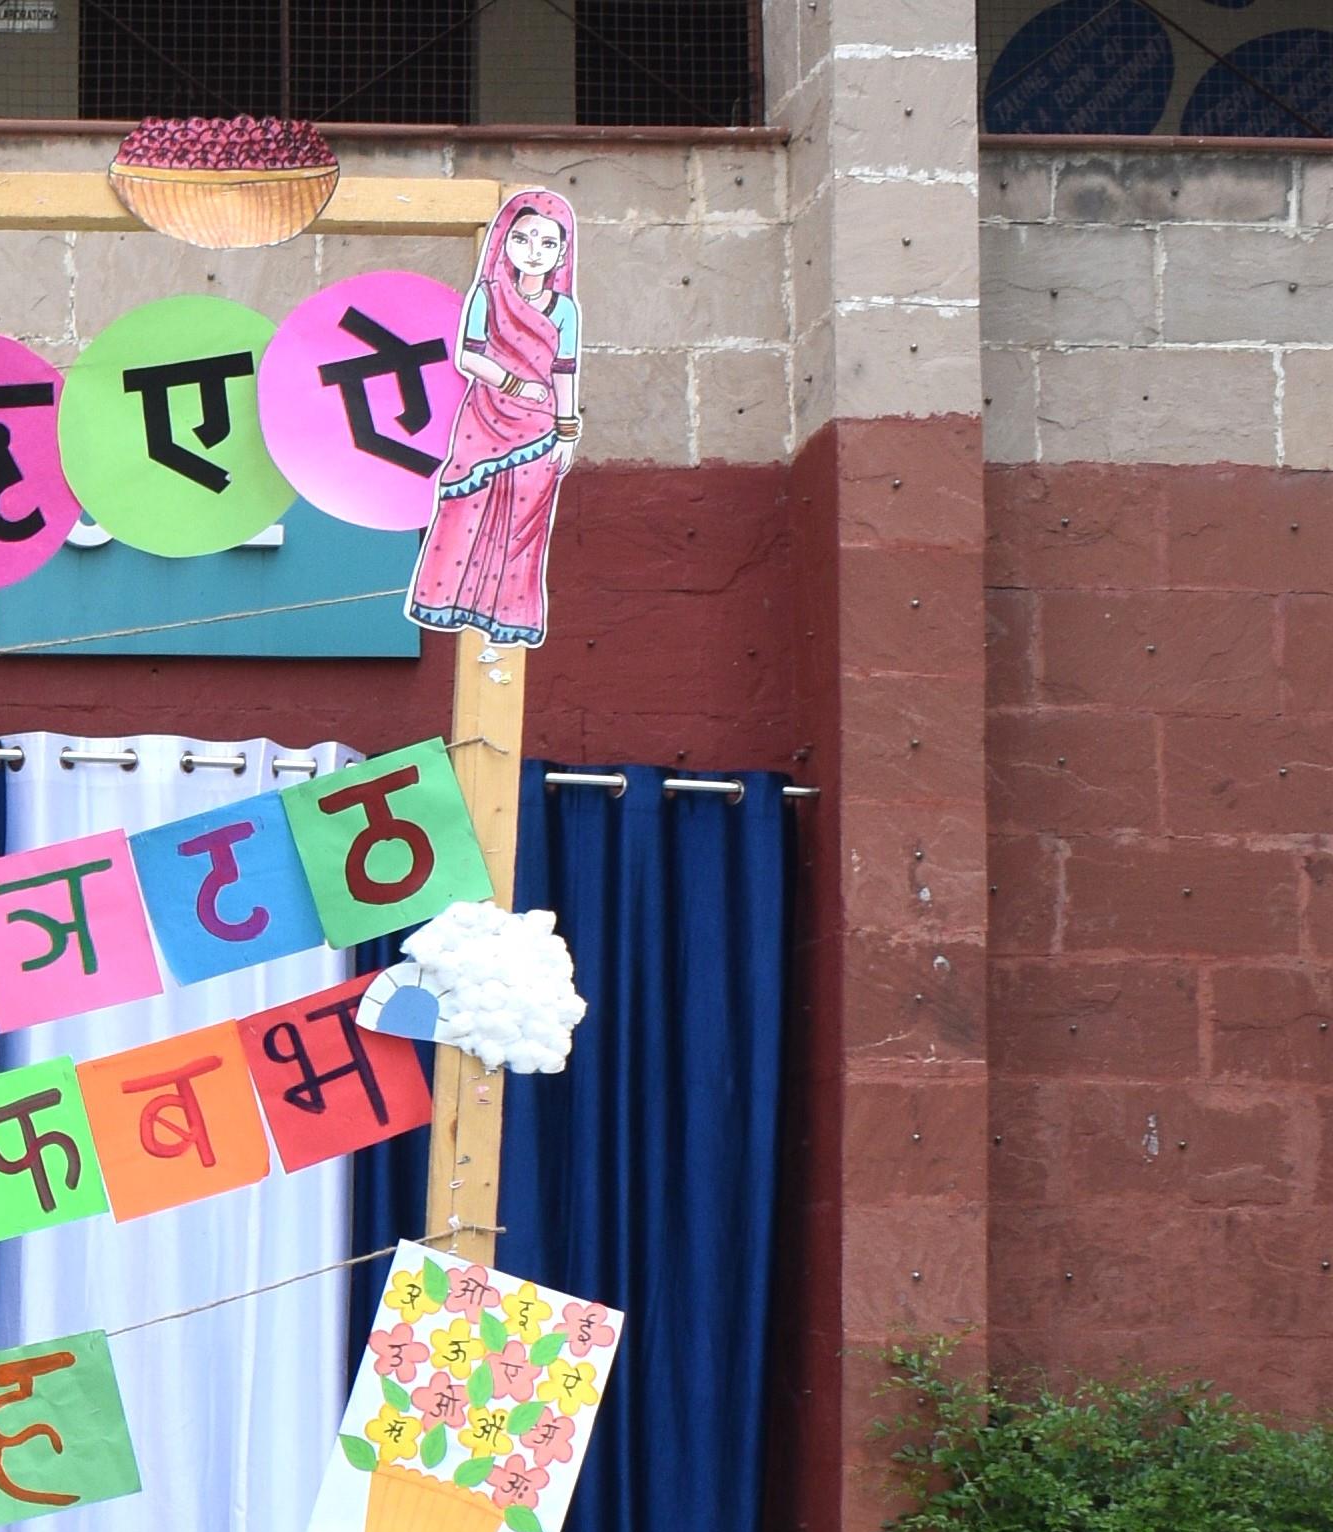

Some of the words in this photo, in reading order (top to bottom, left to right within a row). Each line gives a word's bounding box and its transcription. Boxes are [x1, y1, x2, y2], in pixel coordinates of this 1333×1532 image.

[123, 351, 254, 494] ए
[318, 305, 448, 478] ऐ
[178, 821, 270, 943] ट
[317, 764, 435, 905] ठ
[121, 1055, 223, 1168] ब
[262, 1000, 390, 1126] भ
